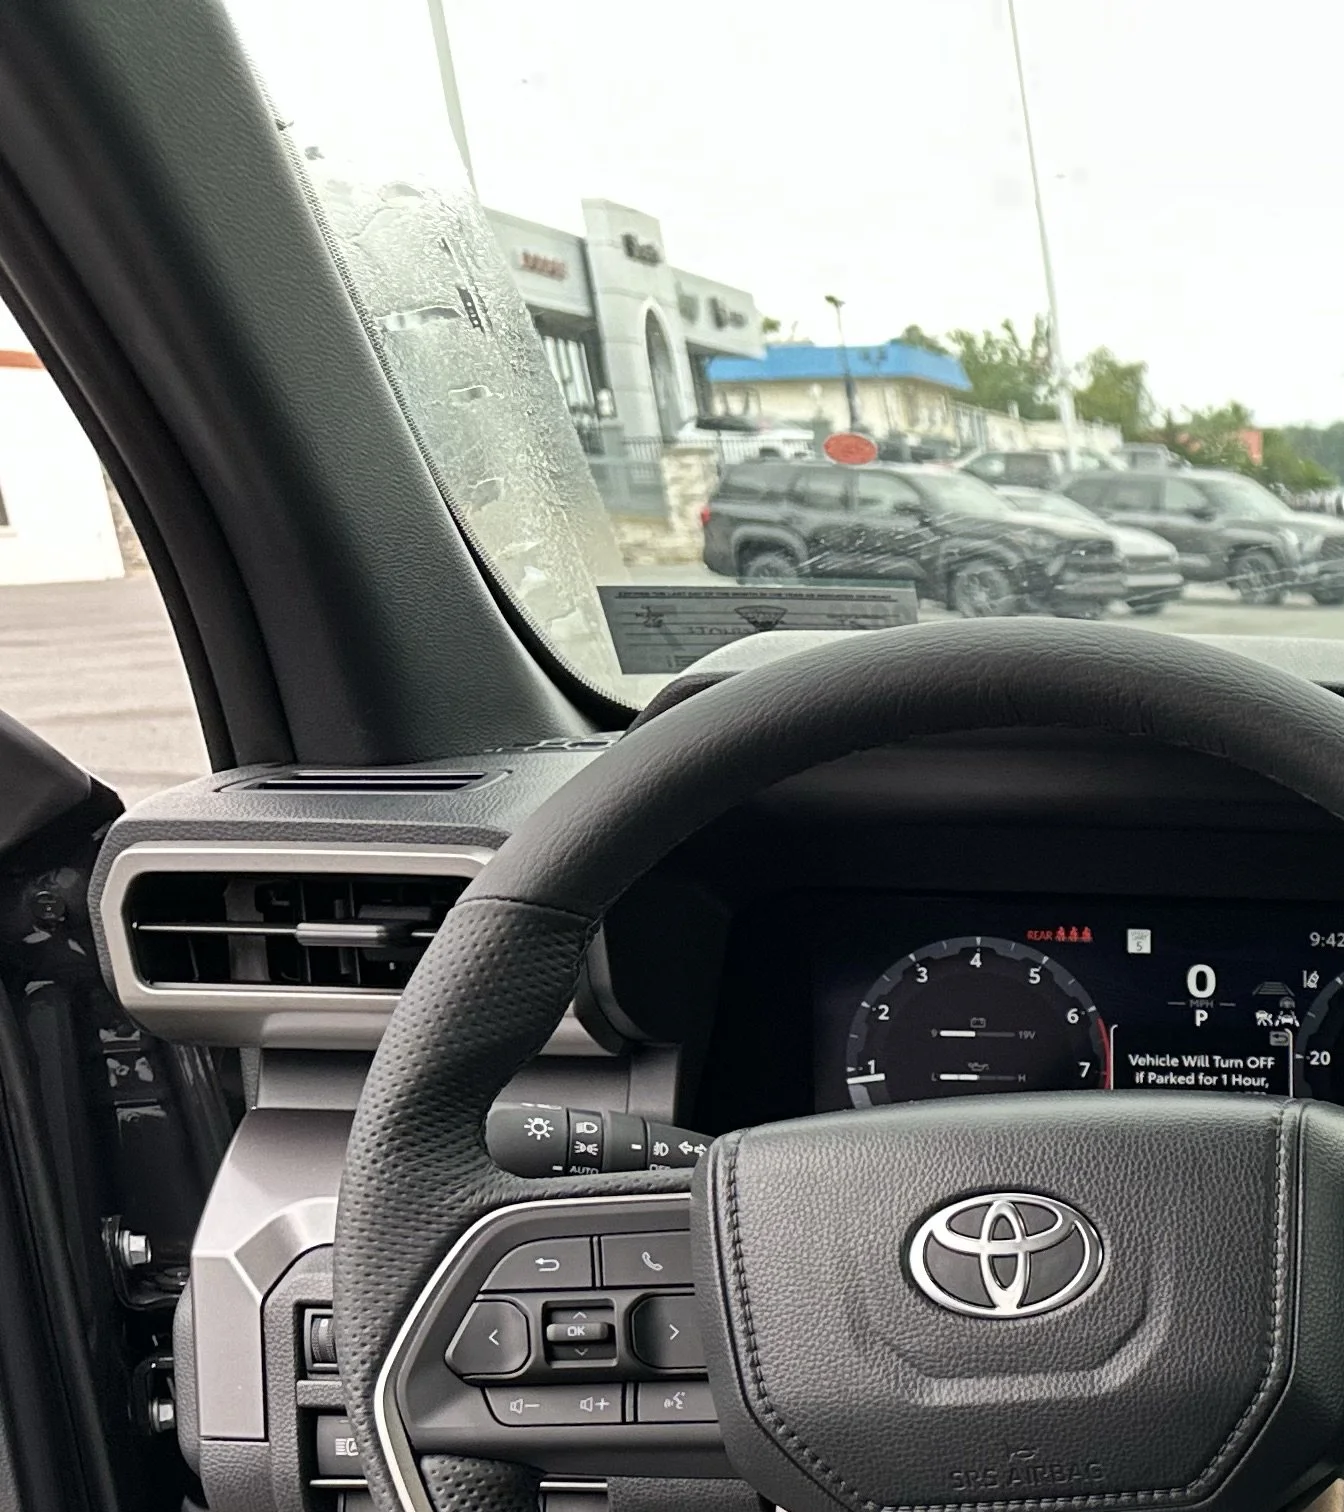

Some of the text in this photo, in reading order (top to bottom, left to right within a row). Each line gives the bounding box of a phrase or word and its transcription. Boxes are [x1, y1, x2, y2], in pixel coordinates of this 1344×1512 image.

[1027, 930, 1053, 941] REAR
[969, 952, 982, 969] 4
[916, 966, 929, 984] 3
[1028, 967, 1041, 985] 5
[1185, 963, 1218, 1000] 0
[877, 1003, 890, 1022] 2
[1066, 1007, 1079, 1025] 6
[1194, 1009, 1209, 1027] P
[866, 1059, 877, 1075] 1
[1127, 1053, 1276, 1070] Vehicle Will Turn OFF
[1308, 1050, 1332, 1067] 20
[1077, 1061, 1091, 1078] 7
[1135, 1070, 1270, 1089] if Parked for 1 Hour,
[569, 1165, 600, 1176] AUTO
[566, 1324, 586, 1339] OK
